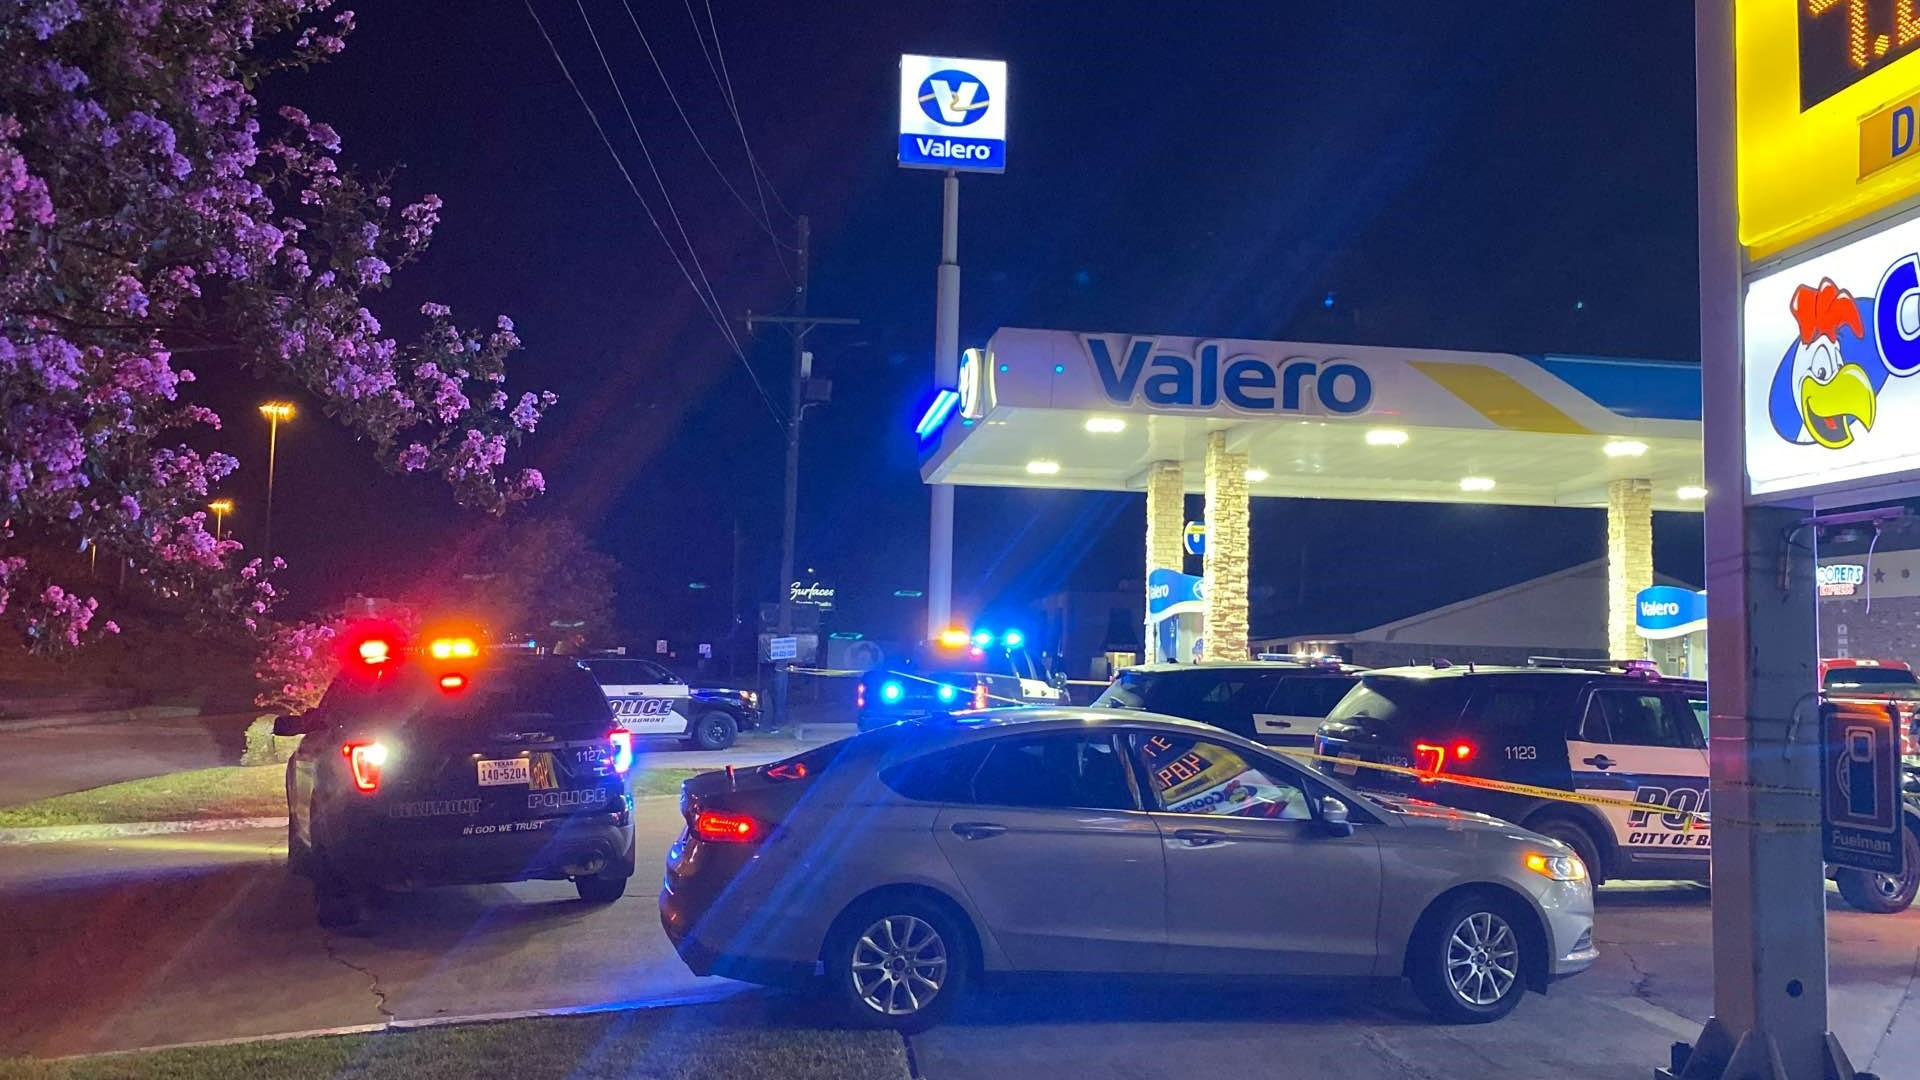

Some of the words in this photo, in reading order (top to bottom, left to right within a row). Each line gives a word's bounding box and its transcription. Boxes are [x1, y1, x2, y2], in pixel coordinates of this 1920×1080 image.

[1891, 105, 1920, 158] D
[916, 137, 991, 160] Valero
[1087, 337, 1373, 414] Valero
[790, 581, 835, 601] Surfaces
[1640, 600, 1680, 617] Valero
[608, 699, 675, 716] OLICE
[576, 749, 602, 762] 1127
[1504, 745, 1537, 760] 1123
[481, 767, 527, 781] 140-5204
[528, 787, 607, 808] POLICE
[463, 827, 473, 835] IN
[475, 825, 496, 834] GOD
[498, 823, 513, 832] WE
[515, 821, 544, 831] TRUST
[1628, 832, 1670, 845] CITY
[1671, 834, 1694, 845] OF
[1695, 834, 1711, 846] B
[1831, 830, 1892, 853] Fuelman
